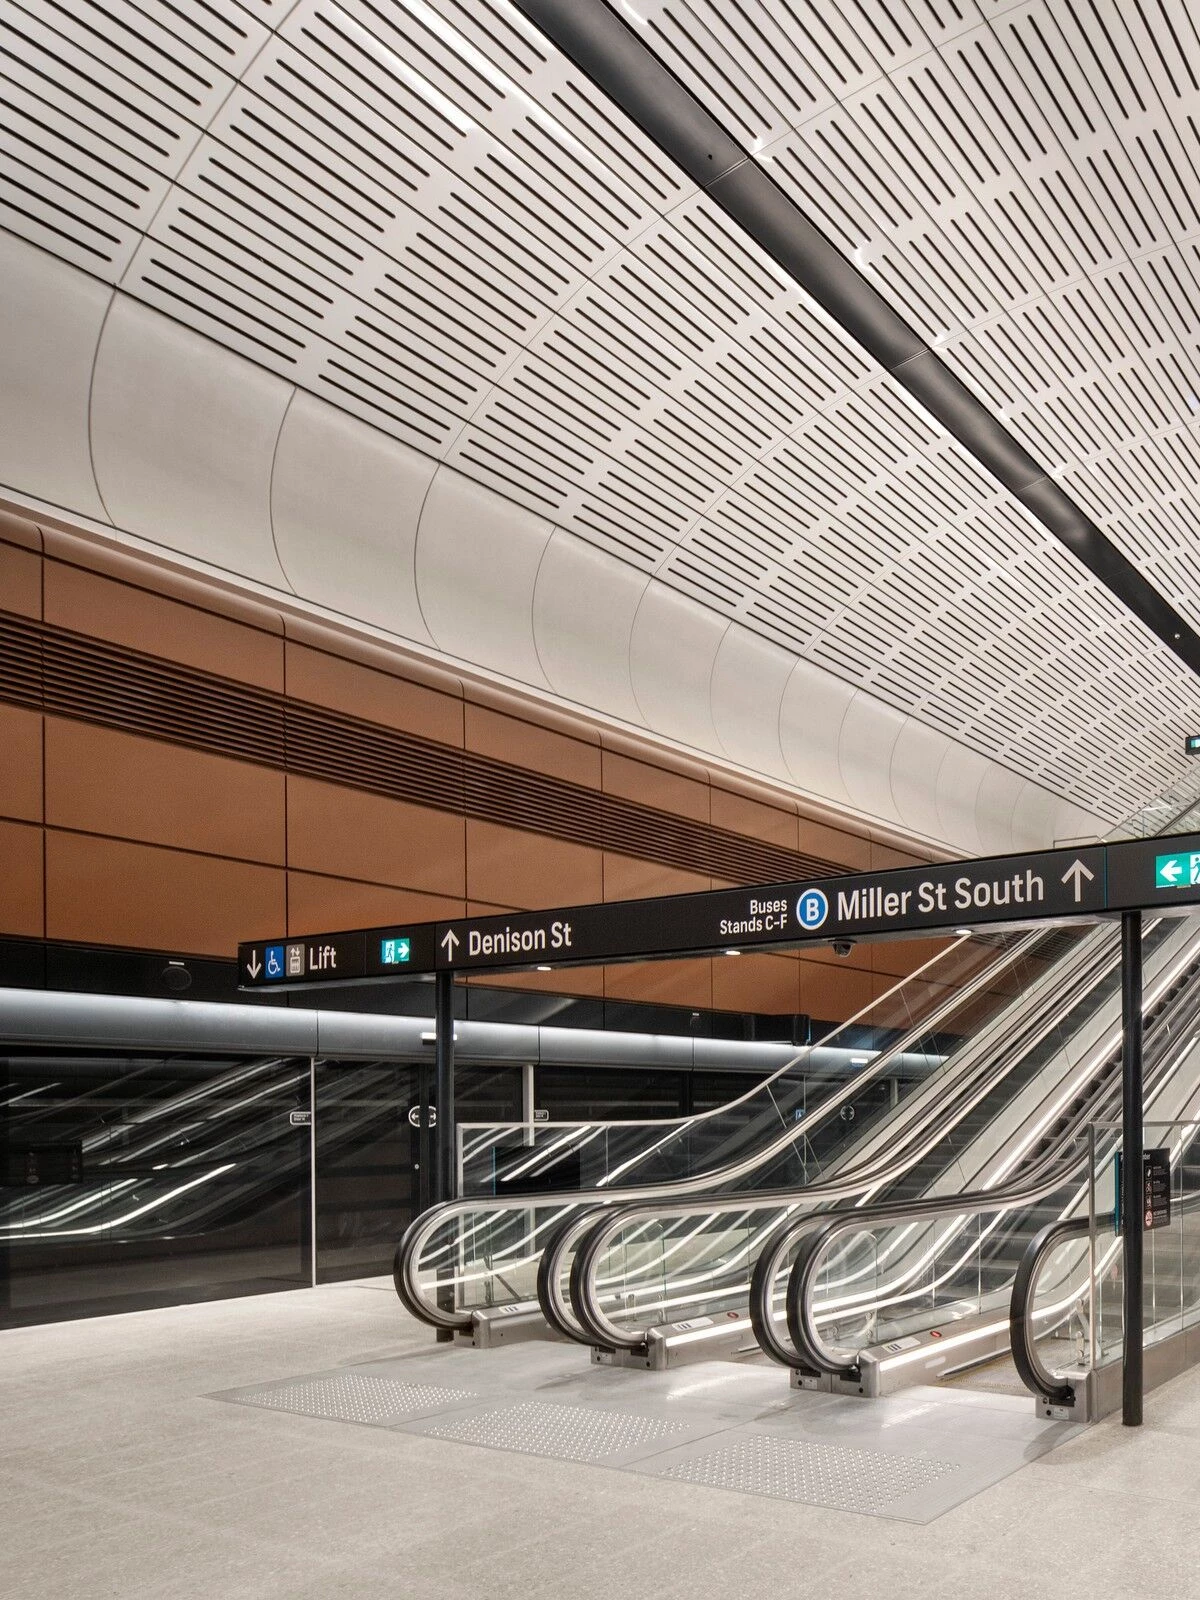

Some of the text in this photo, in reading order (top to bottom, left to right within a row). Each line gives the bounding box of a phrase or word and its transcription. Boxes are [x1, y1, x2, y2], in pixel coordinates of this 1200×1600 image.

[750, 899, 788, 915] Buses
[837, 870, 1044, 921] Miller St South
[720, 913, 788, 935] Stands C-F
[469, 921, 572, 956] Denison St
[309, 945, 337, 971] Lift
